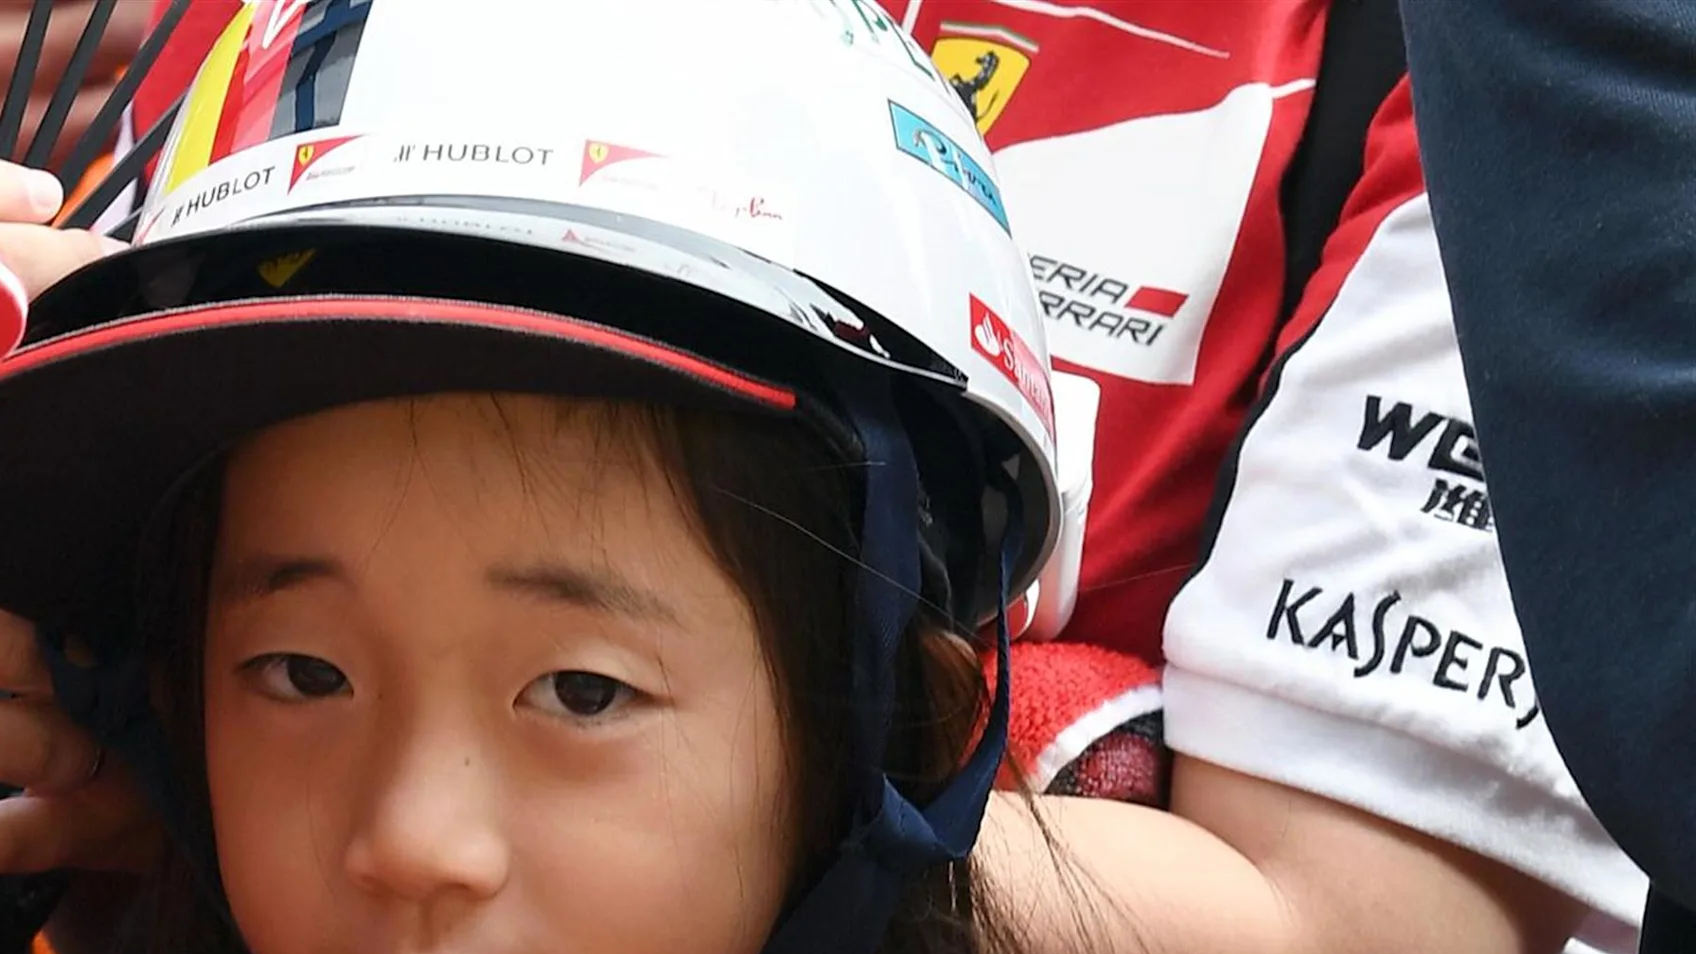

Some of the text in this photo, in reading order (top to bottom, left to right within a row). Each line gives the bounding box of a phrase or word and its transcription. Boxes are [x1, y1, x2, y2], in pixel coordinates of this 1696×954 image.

[423, 143, 554, 166] HUBLOT
[185, 166, 276, 218] HUBLOT
[1027, 252, 1130, 304] ERIA
